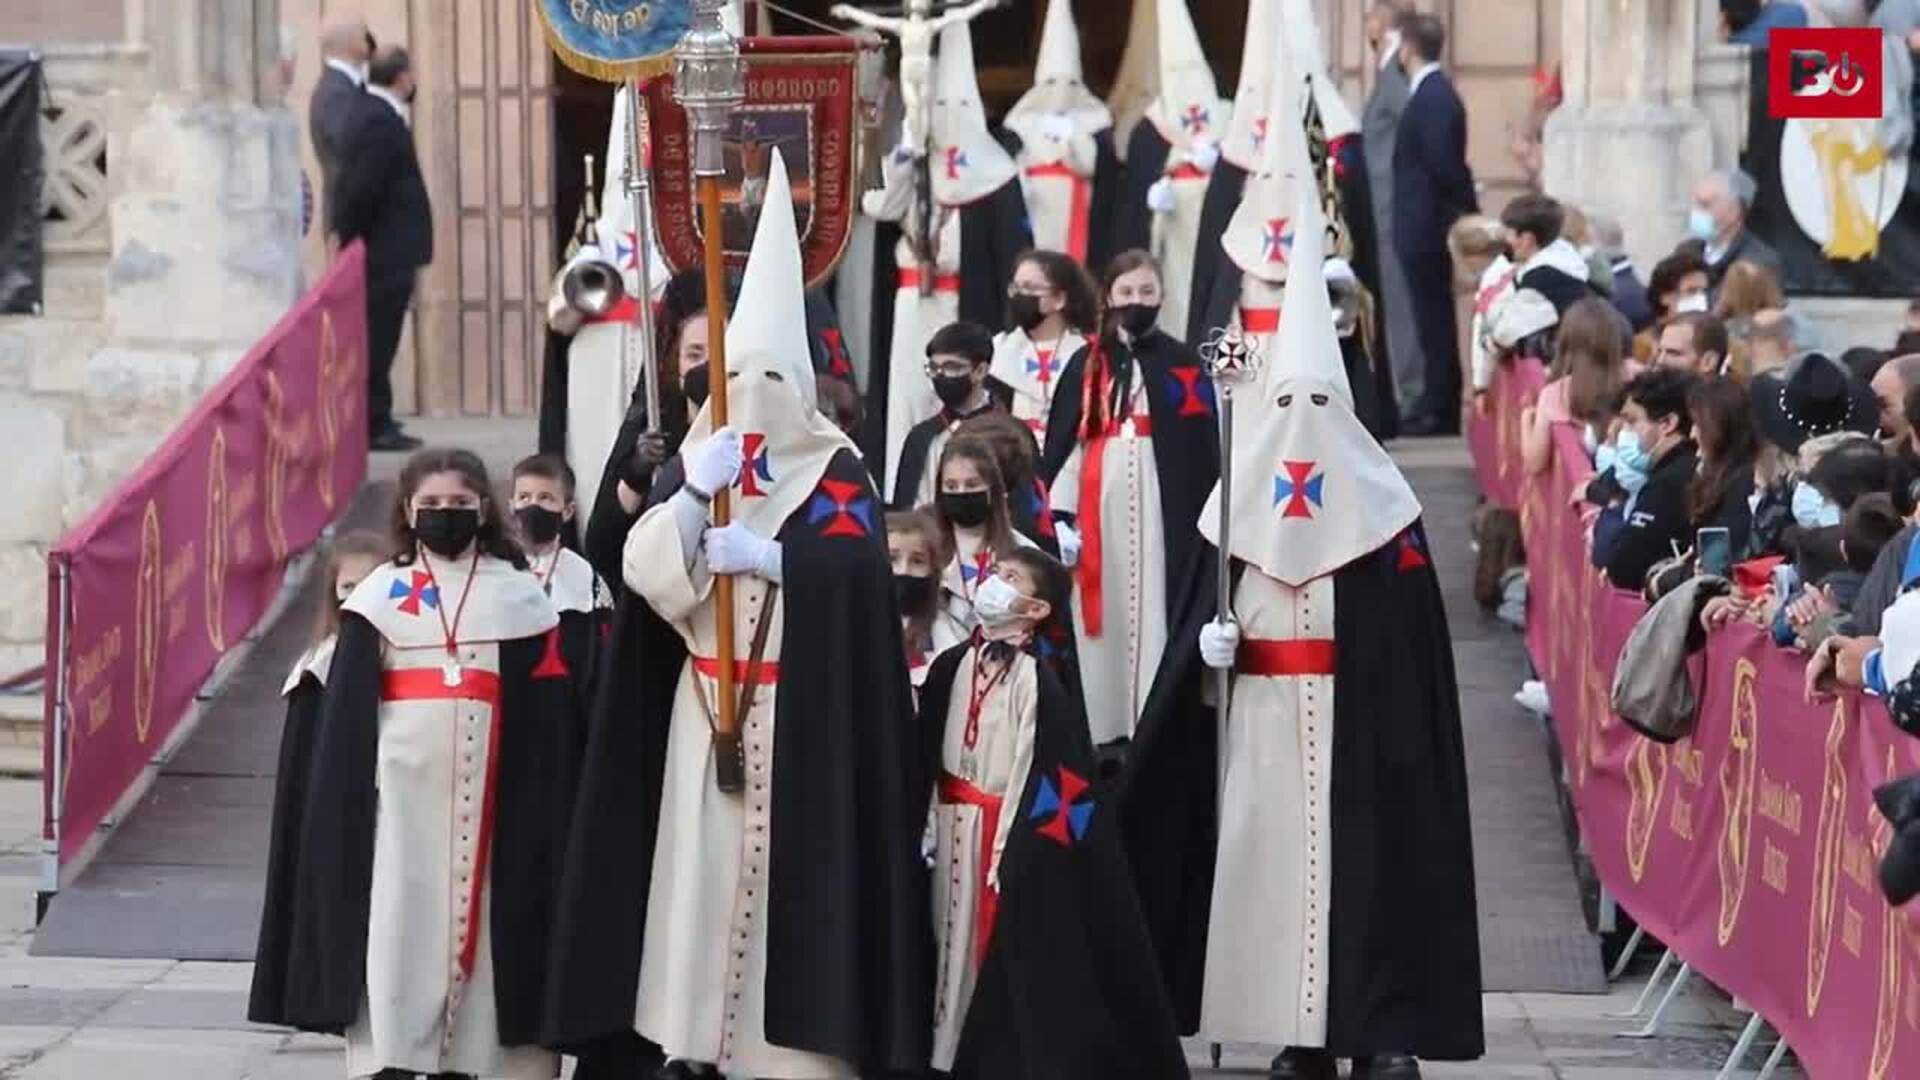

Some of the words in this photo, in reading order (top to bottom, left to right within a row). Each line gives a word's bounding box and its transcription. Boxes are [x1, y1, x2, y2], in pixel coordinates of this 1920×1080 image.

[592, 10, 620, 38] los
[623, 3, 649, 29] de
[819, 128, 841, 209] BURGOS
